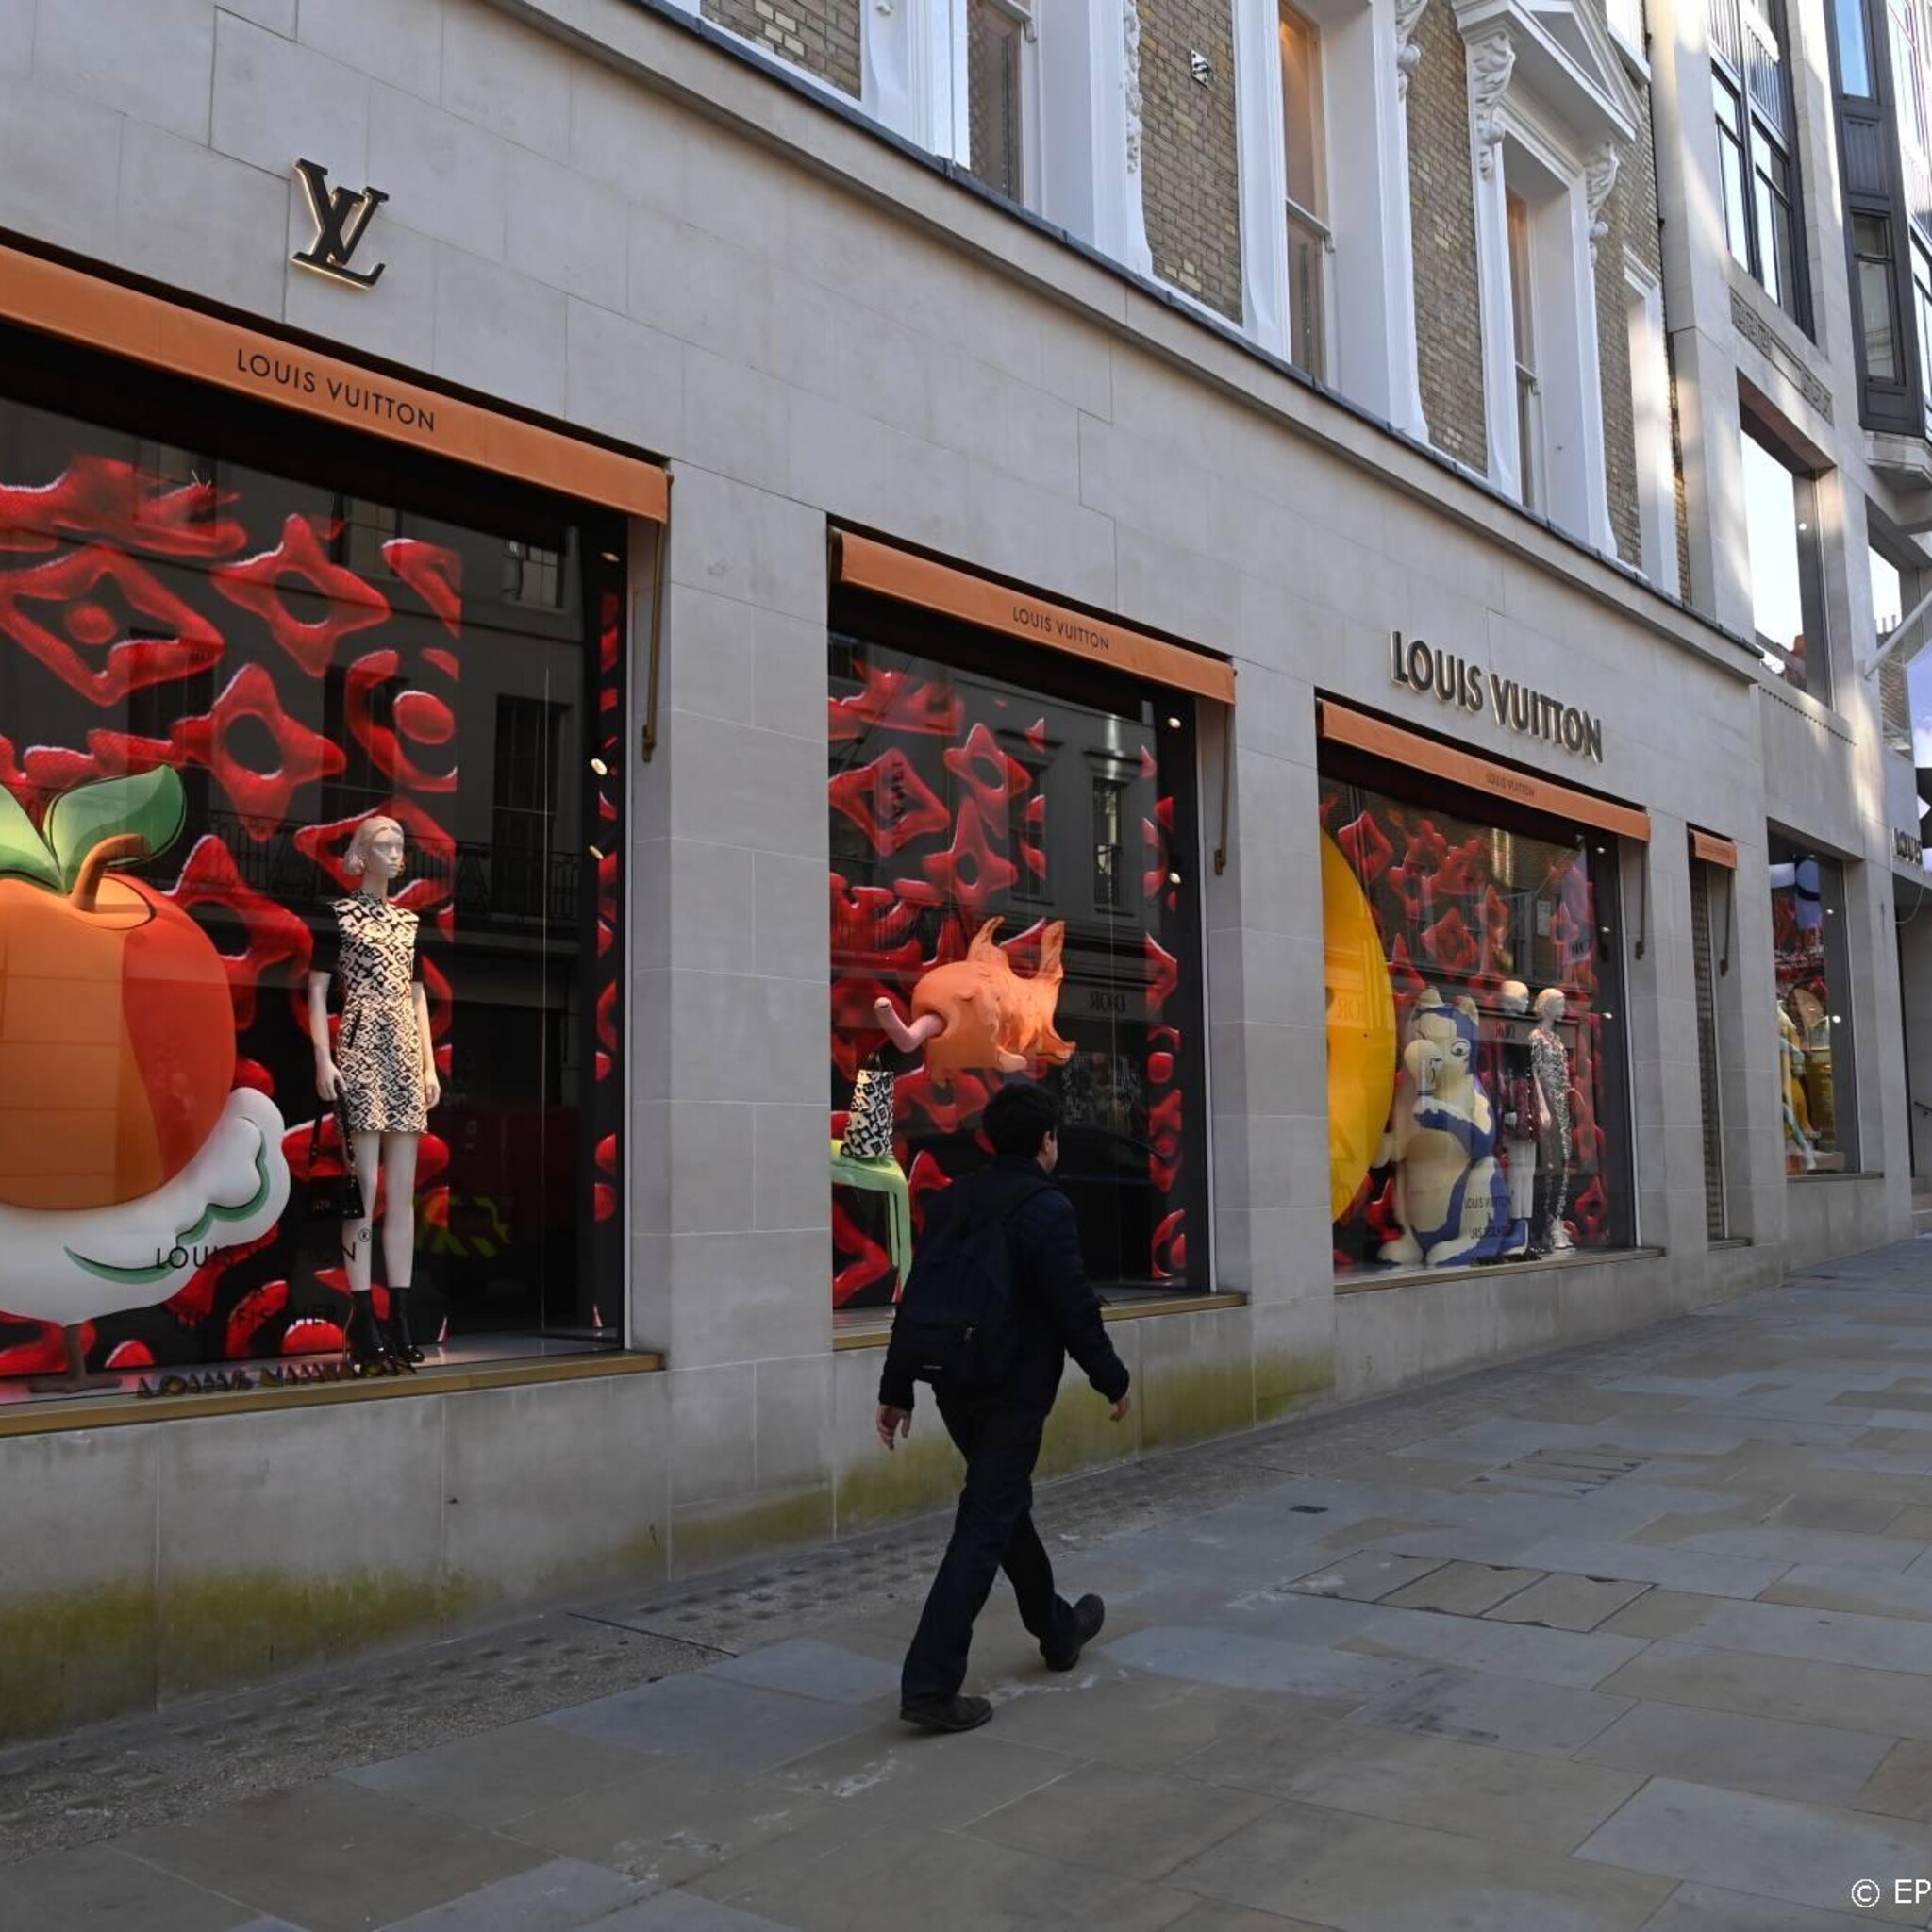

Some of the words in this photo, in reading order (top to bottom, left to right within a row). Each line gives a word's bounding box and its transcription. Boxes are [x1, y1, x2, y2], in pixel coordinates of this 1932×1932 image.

[237, 348, 316, 393] LOUIS
[326, 377, 435, 433] VUITTON
[1012, 606, 1052, 633] LOUIS
[1056, 621, 1110, 651] VUITTON
[1391, 630, 1484, 713] LOUIS
[1489, 673, 1604, 764] VUITTON
